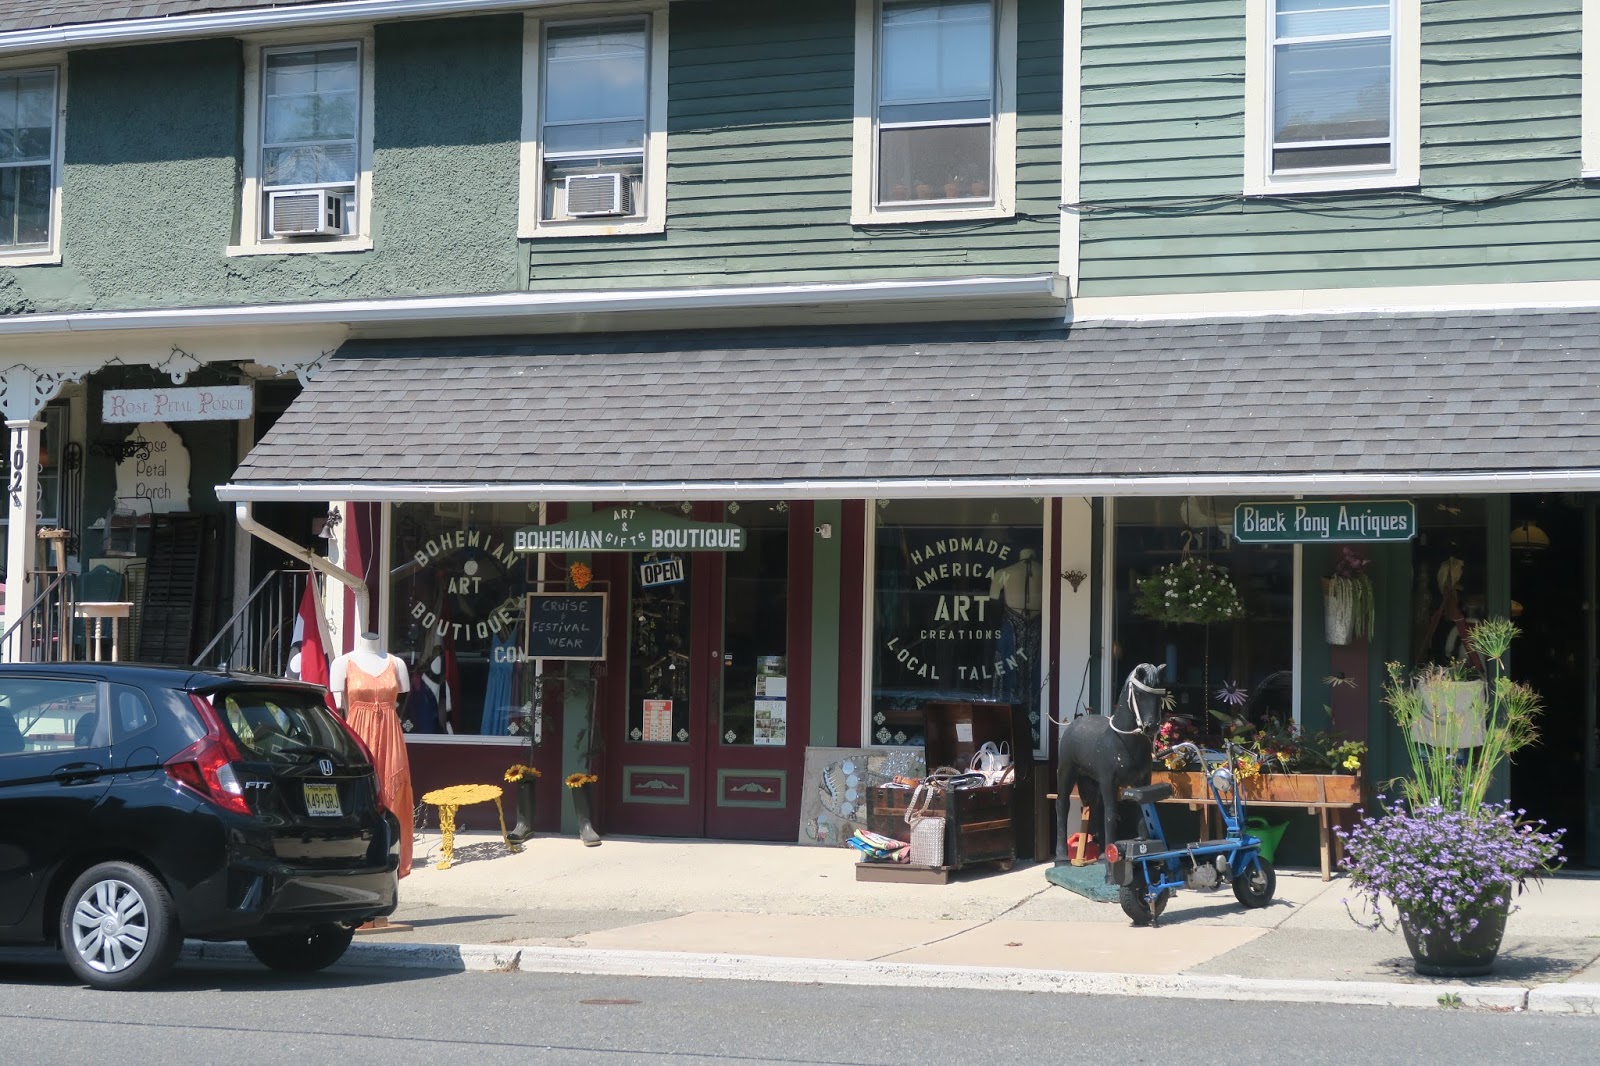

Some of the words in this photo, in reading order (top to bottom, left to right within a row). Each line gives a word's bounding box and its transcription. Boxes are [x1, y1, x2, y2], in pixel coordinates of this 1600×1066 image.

[13, 428, 24, 492] 102
[136, 459, 167, 477] Petal
[136, 482, 171, 499] Porch
[613, 509, 636, 521] ART
[1243, 506, 1286, 532] Black
[1294, 506, 1330, 538] Pony
[1337, 505, 1407, 537] Antiques
[621, 522, 628, 532] &
[414, 530, 518, 568] BOHEMIAN
[515, 530, 603, 549] BOHEMIAN
[652, 529, 741, 548] BOUTIQUE
[605, 532, 646, 548] GIFTS
[910, 537, 1012, 565] HANDMADE
[643, 562, 680, 584] OPEN
[915, 562, 1011, 591] AMERICAN
[448, 577, 482, 594] ART
[934, 595, 990, 622] ART
[411, 601, 513, 641] BOUTIQUE
[547, 637, 583, 648] WEAR
[920, 629, 1002, 640] CREATIONS
[887, 637, 940, 680] LOCAL
[958, 647, 1028, 680] TALENT
[245, 781, 271, 789] FIT
